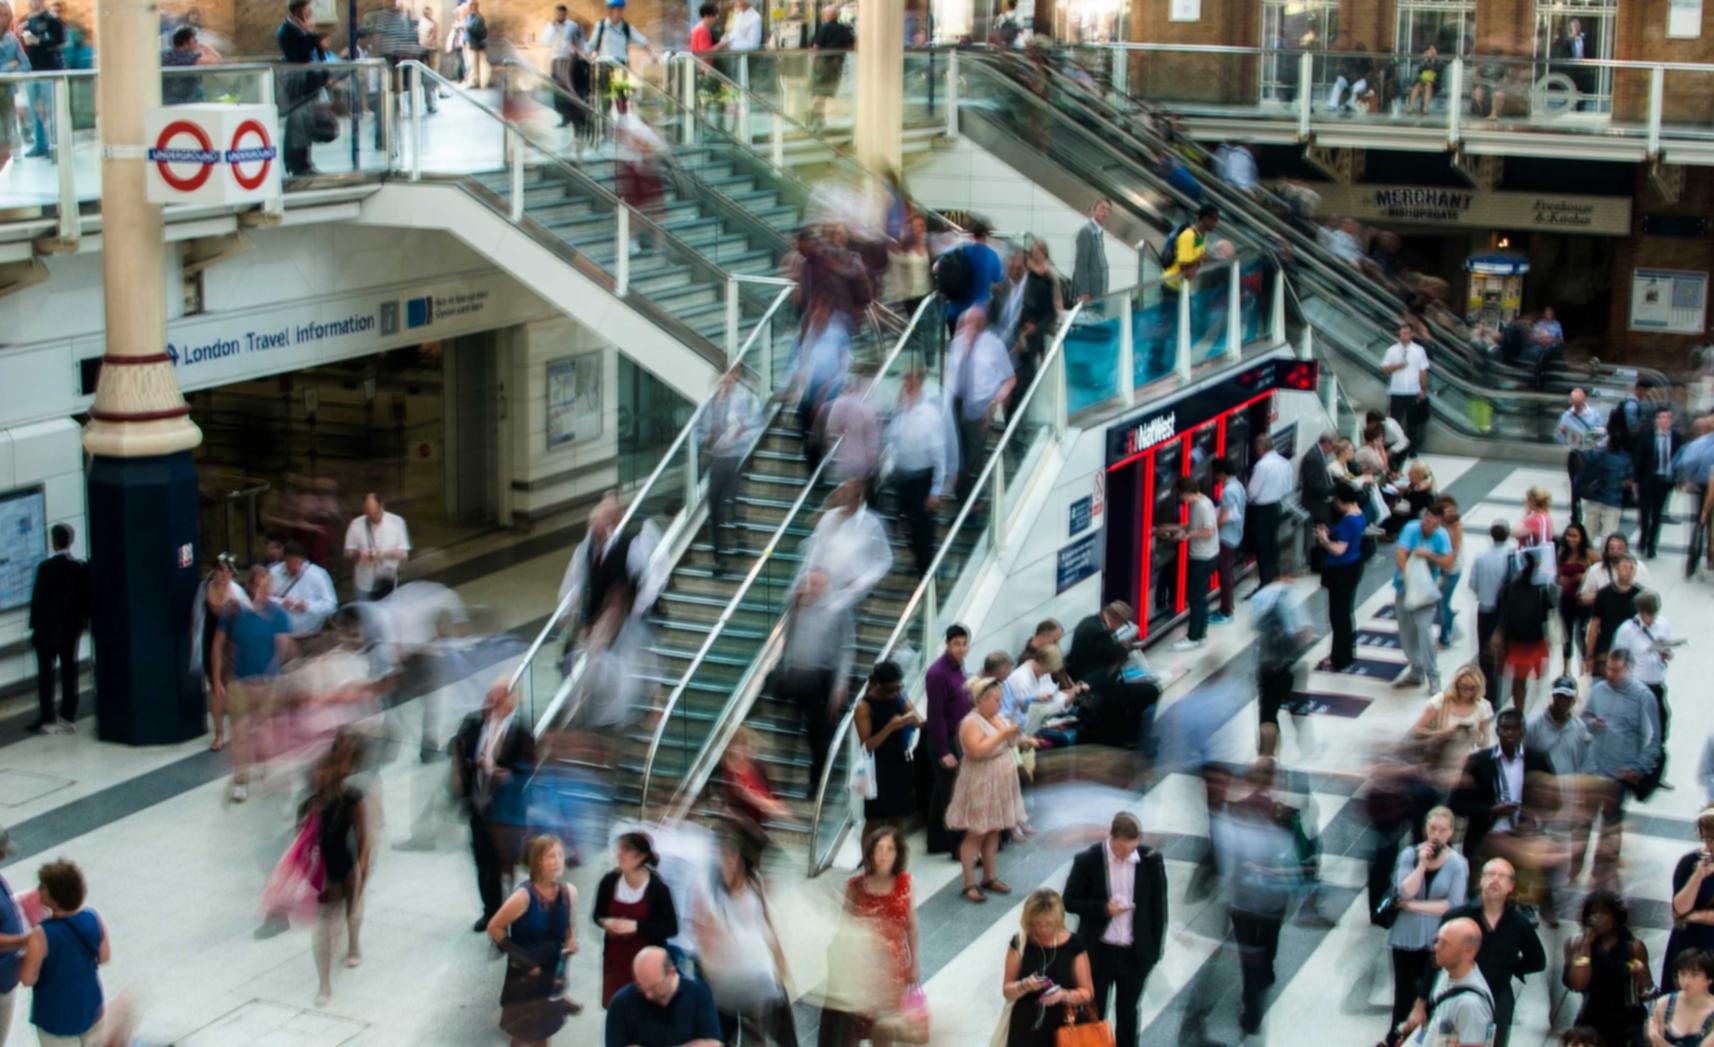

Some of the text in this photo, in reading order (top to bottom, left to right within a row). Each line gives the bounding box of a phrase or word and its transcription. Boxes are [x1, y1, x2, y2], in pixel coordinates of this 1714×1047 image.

[153, 150, 218, 162] UNDERGROUND
[228, 147, 273, 162] UNDERGROUND
[1376, 188, 1472, 210] MERCHANT
[184, 313, 375, 365] London Travel Information
[1139, 410, 1175, 450] NatWest
